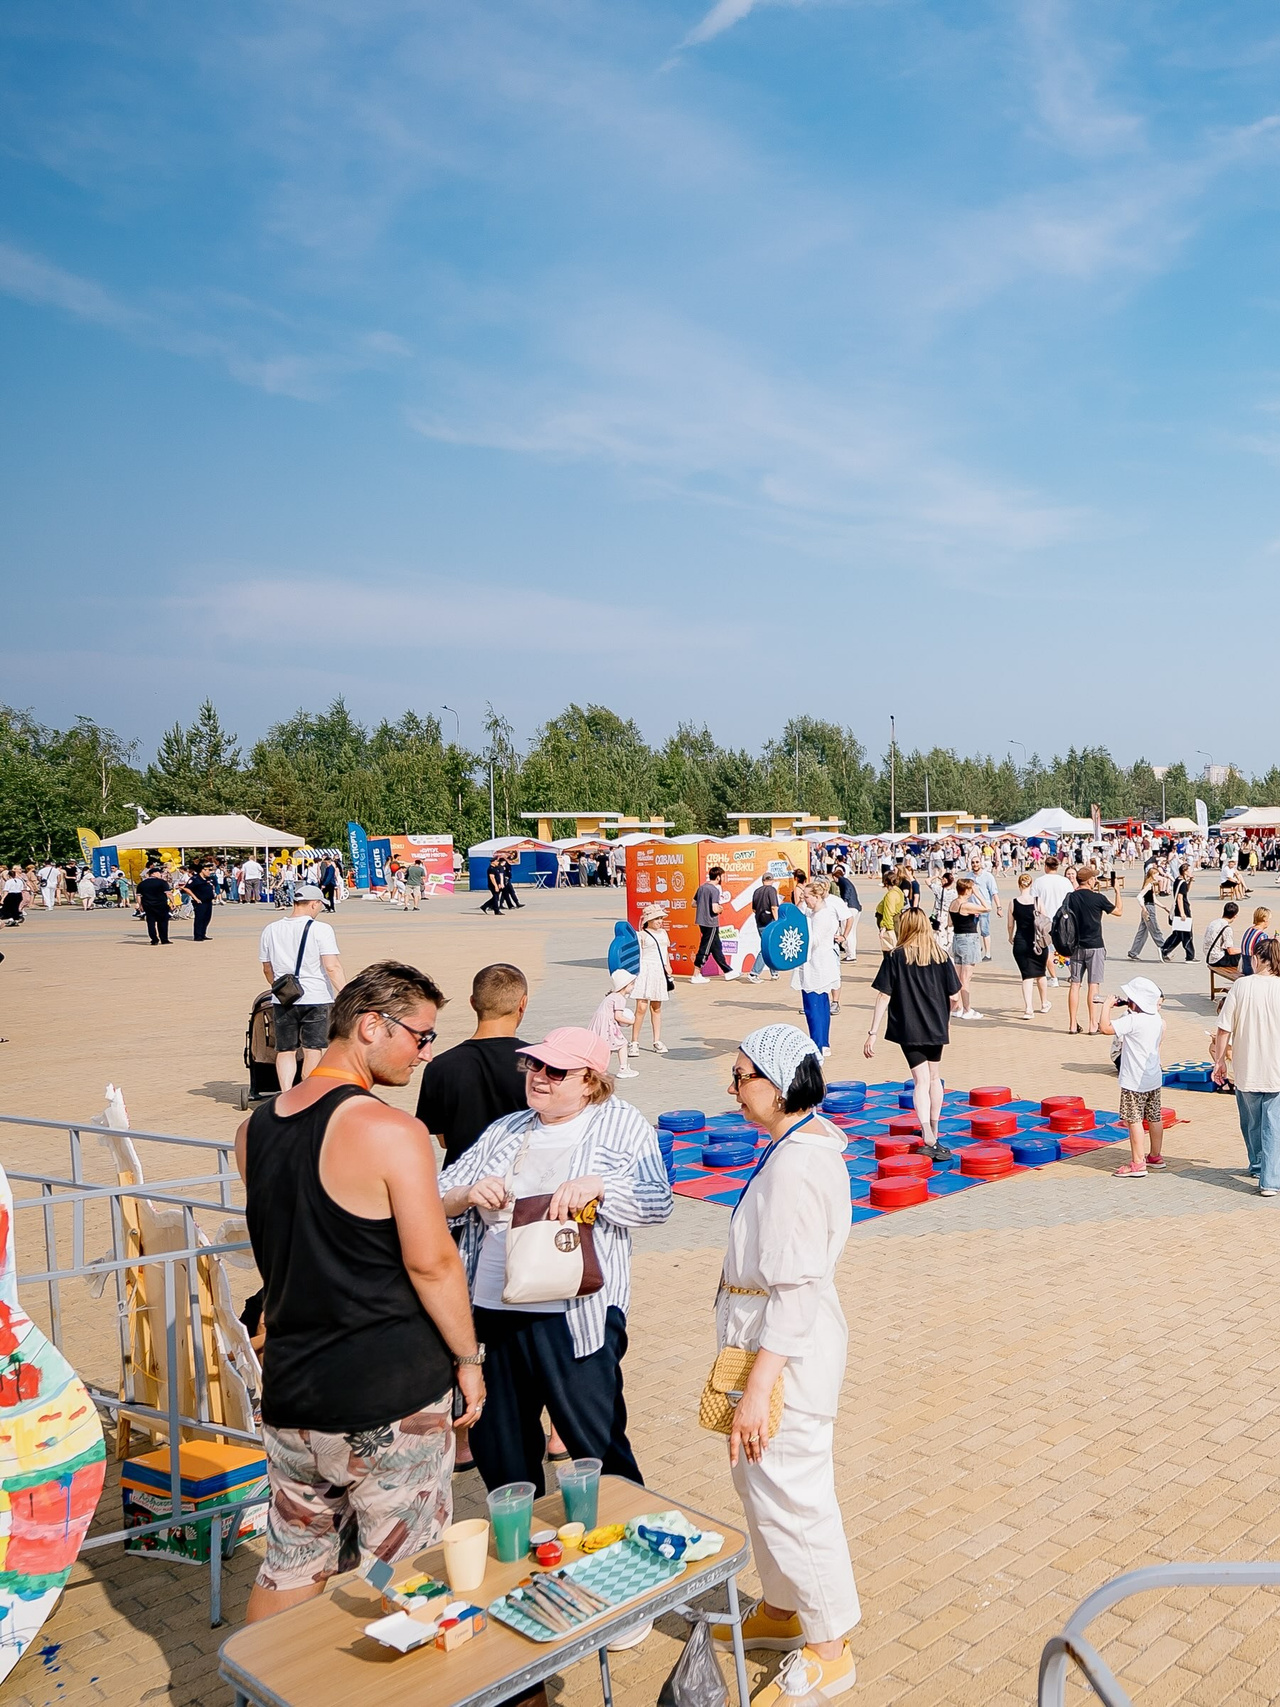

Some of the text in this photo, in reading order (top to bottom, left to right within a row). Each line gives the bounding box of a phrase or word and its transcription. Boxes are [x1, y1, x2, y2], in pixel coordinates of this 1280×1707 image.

[350, 830, 360, 859] СПОРТА
[373, 848, 382, 869] СНГБ
[705, 853, 730, 863] ДЕНЬ
